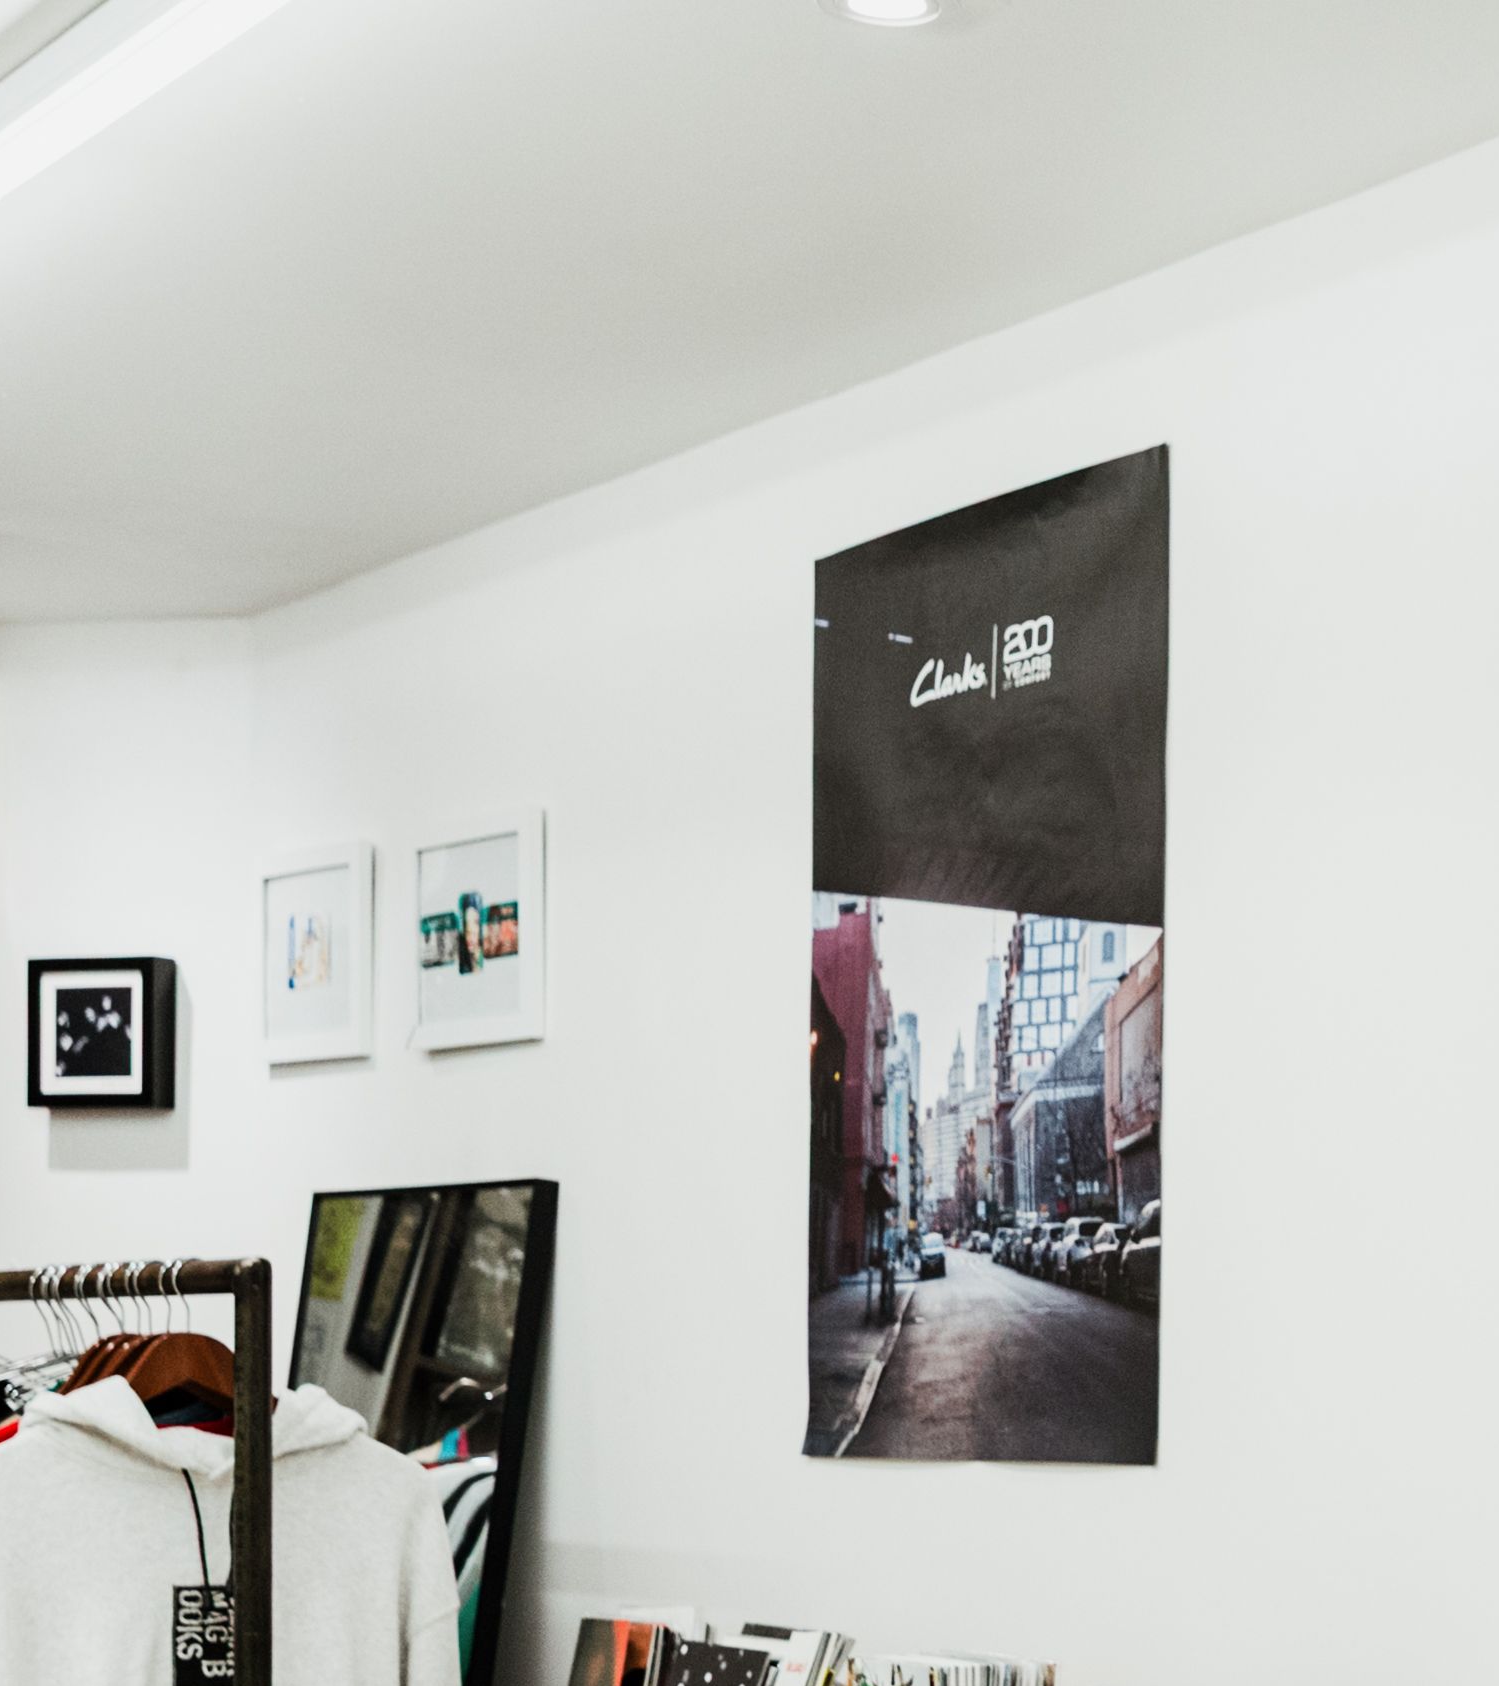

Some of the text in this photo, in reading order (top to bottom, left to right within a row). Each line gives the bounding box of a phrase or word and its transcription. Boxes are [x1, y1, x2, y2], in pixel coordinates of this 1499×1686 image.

[1003, 615, 1054, 664] 200
[910, 653, 988, 708] Clarks
[1003, 653, 1052, 680] YEARS
[176, 1590, 204, 1660] OOKS
